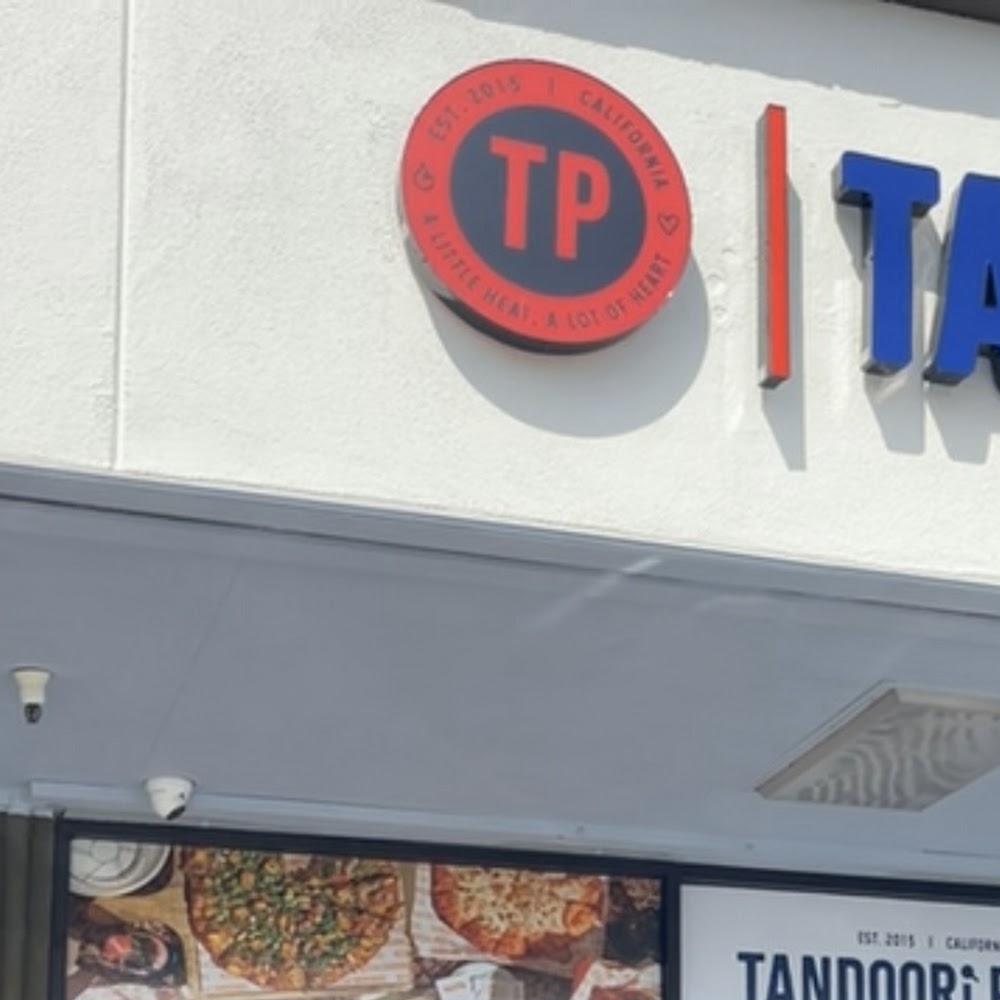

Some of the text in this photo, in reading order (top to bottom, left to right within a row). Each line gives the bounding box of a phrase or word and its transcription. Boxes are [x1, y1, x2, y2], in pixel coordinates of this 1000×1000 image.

[579, 89, 669, 190] CALIFORNIA
[488, 134, 612, 261] TP
[430, 231, 481, 290] LITTLE
[545, 311, 558, 329] A
[567, 309, 600, 330] LOT
[606, 299, 628, 321] OF
[629, 252, 671, 304] HEART
[886, 932, 916, 948] 2015
